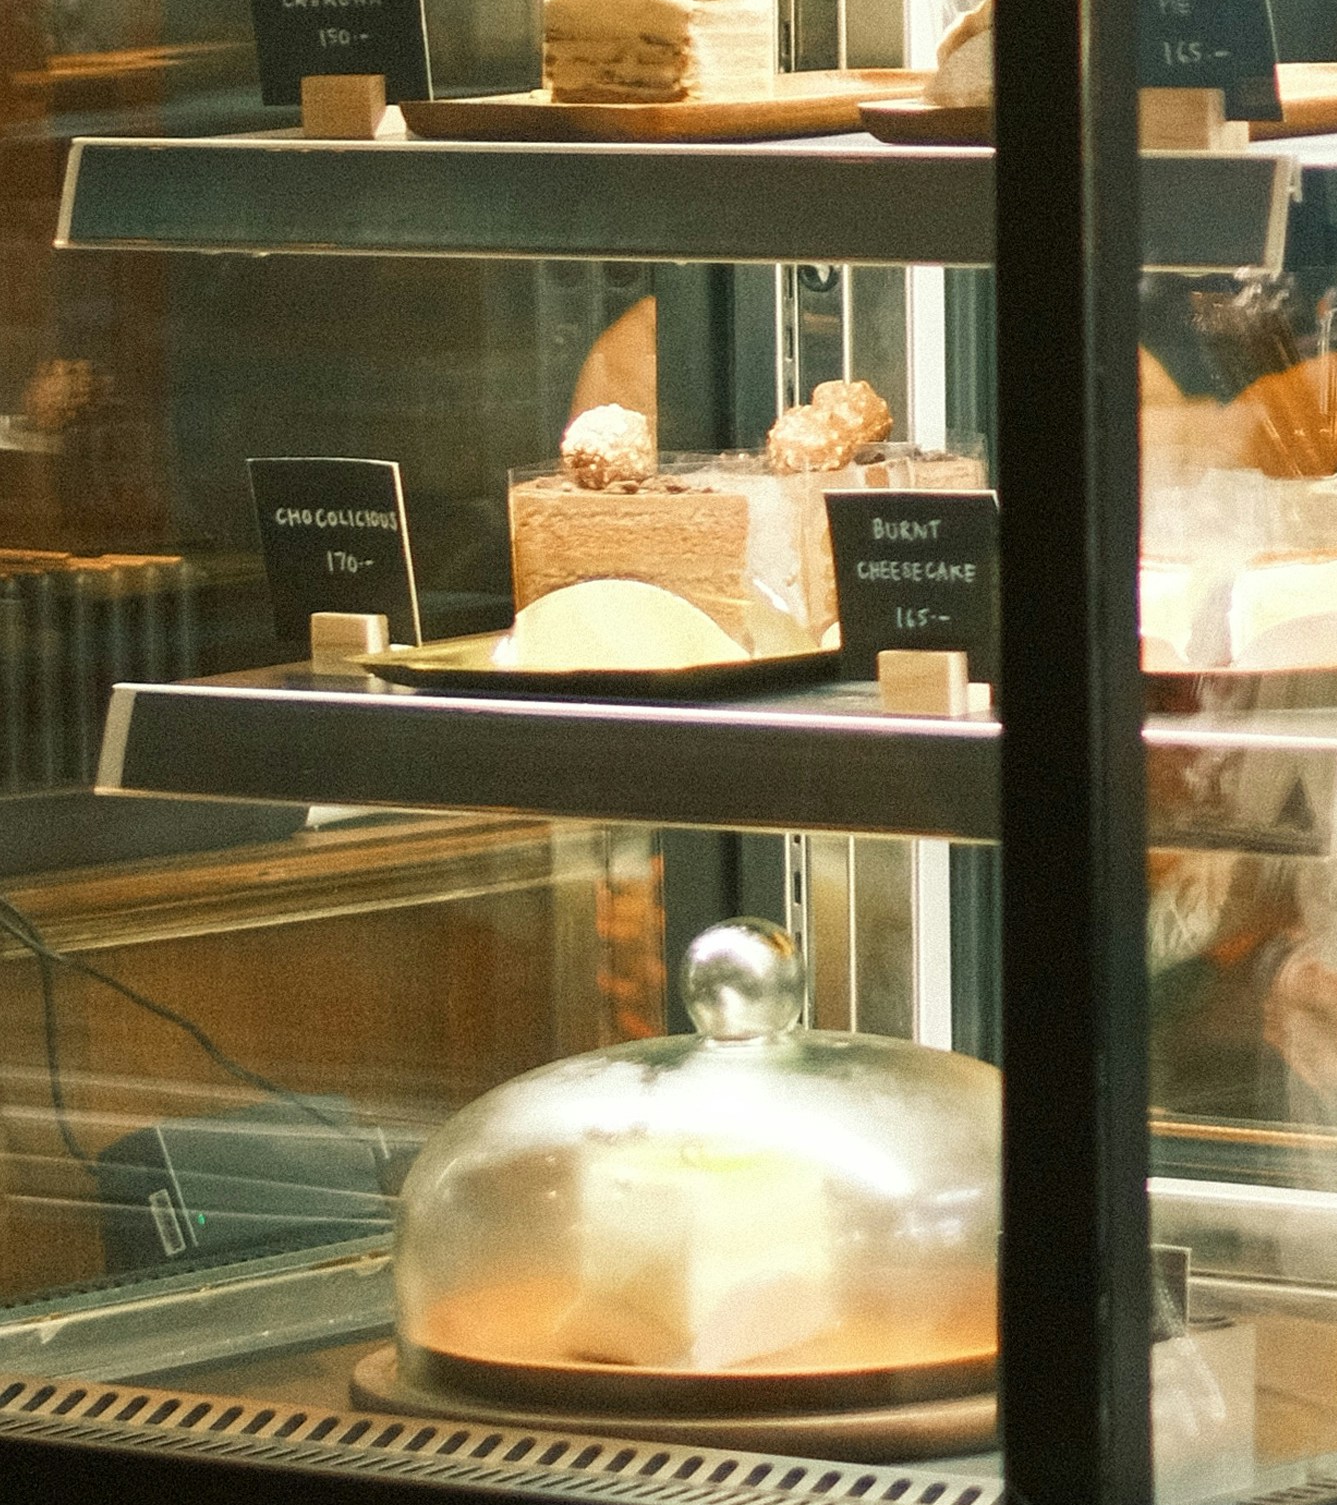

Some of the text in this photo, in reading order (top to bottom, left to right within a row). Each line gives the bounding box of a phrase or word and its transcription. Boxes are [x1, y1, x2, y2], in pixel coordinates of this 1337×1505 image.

[275, 507, 398, 531] CHOCOLICIOUS
[872, 517, 941, 541] BURNT
[857, 560, 976, 583] CHEESECAKE
